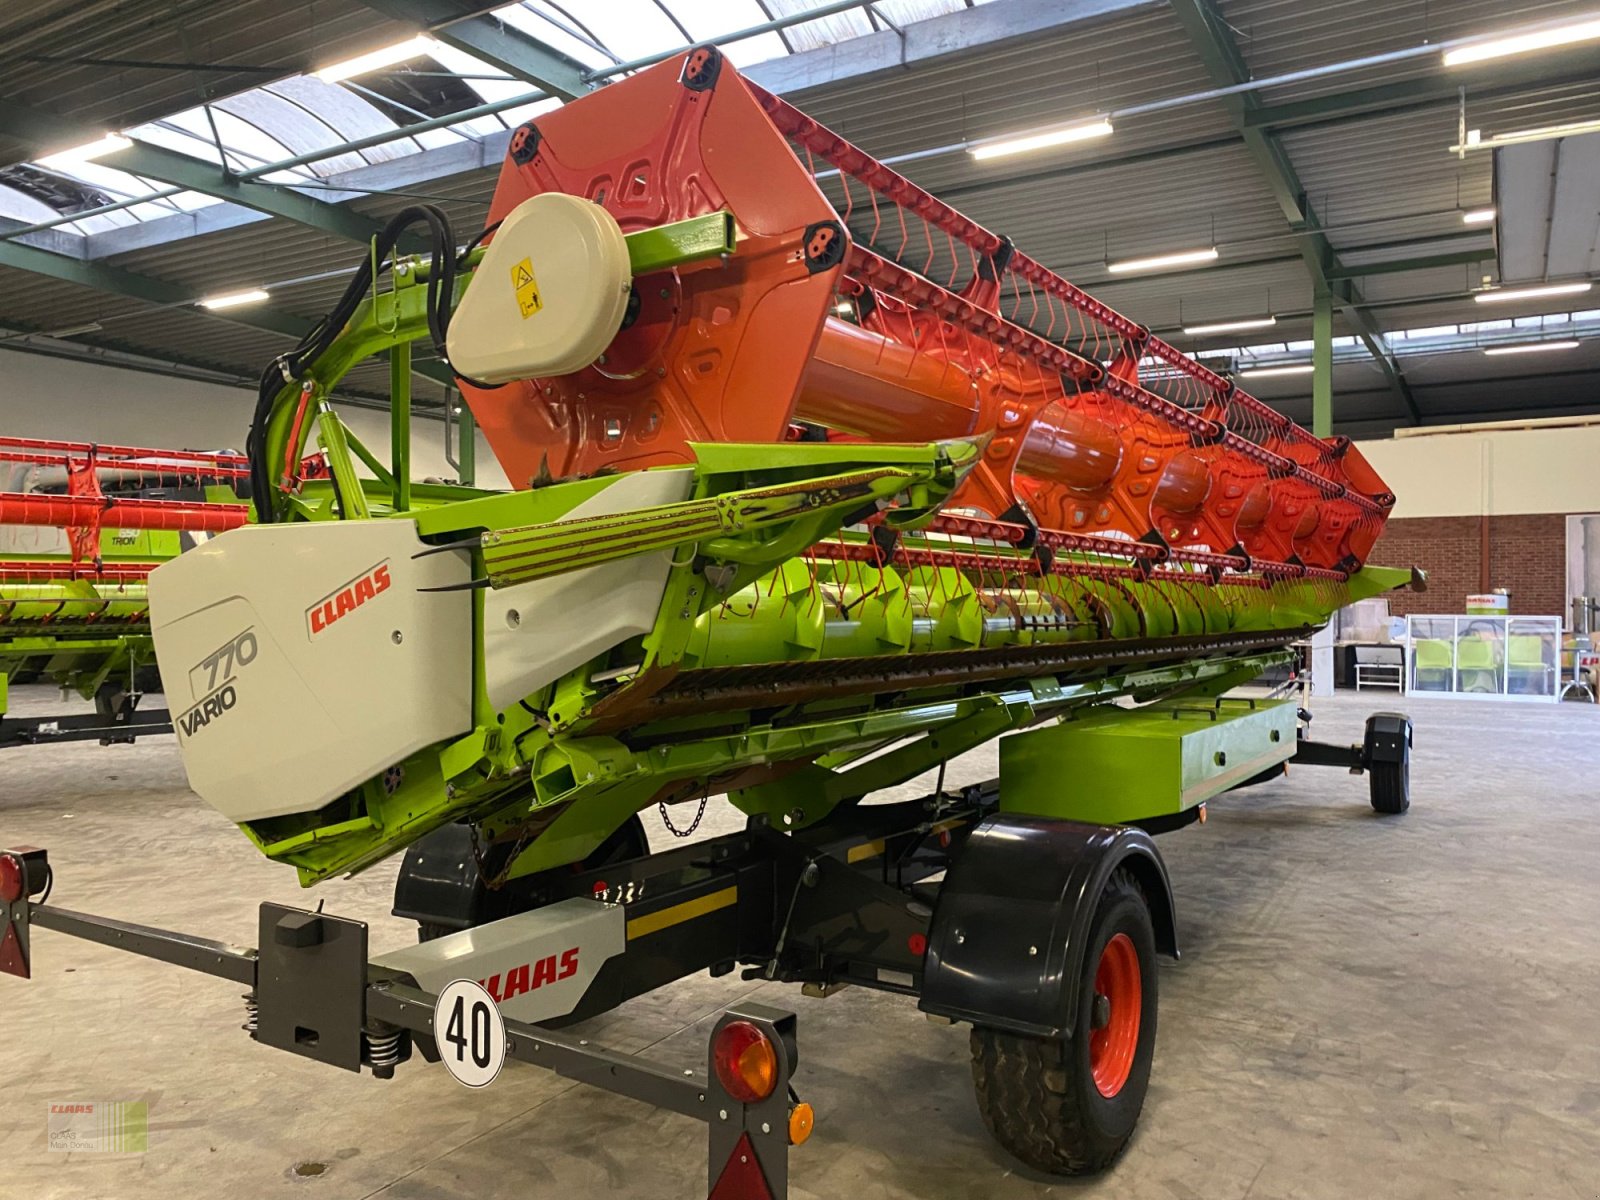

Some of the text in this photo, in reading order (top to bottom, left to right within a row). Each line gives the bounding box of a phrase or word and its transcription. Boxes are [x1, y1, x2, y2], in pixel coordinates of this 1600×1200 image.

[112, 536, 136, 546] TRION
[310, 564, 391, 634] CLAAS
[203, 632, 258, 691] 770
[180, 685, 237, 737] VARIO
[475, 947, 580, 1004] LAAS
[446, 995, 491, 1069] 40
